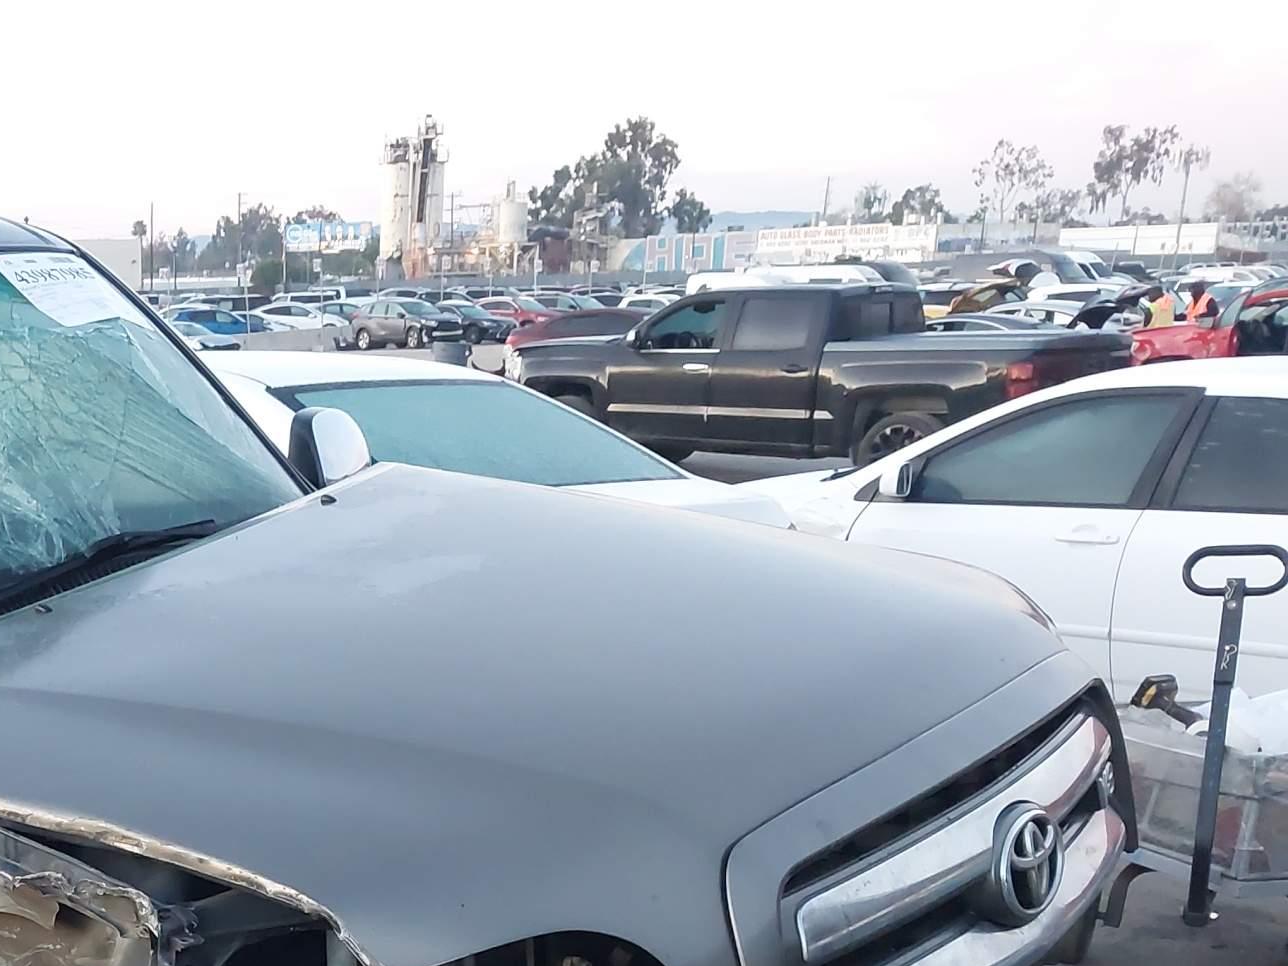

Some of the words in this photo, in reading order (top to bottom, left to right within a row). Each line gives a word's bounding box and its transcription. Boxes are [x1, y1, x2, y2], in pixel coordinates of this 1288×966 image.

[760, 231, 778, 240] AUTO
[779, 230, 802, 240] GLASS
[804, 229, 821, 239] BODY
[824, 227, 846, 237] PARTS
[849, 224, 889, 235] RADIATORS
